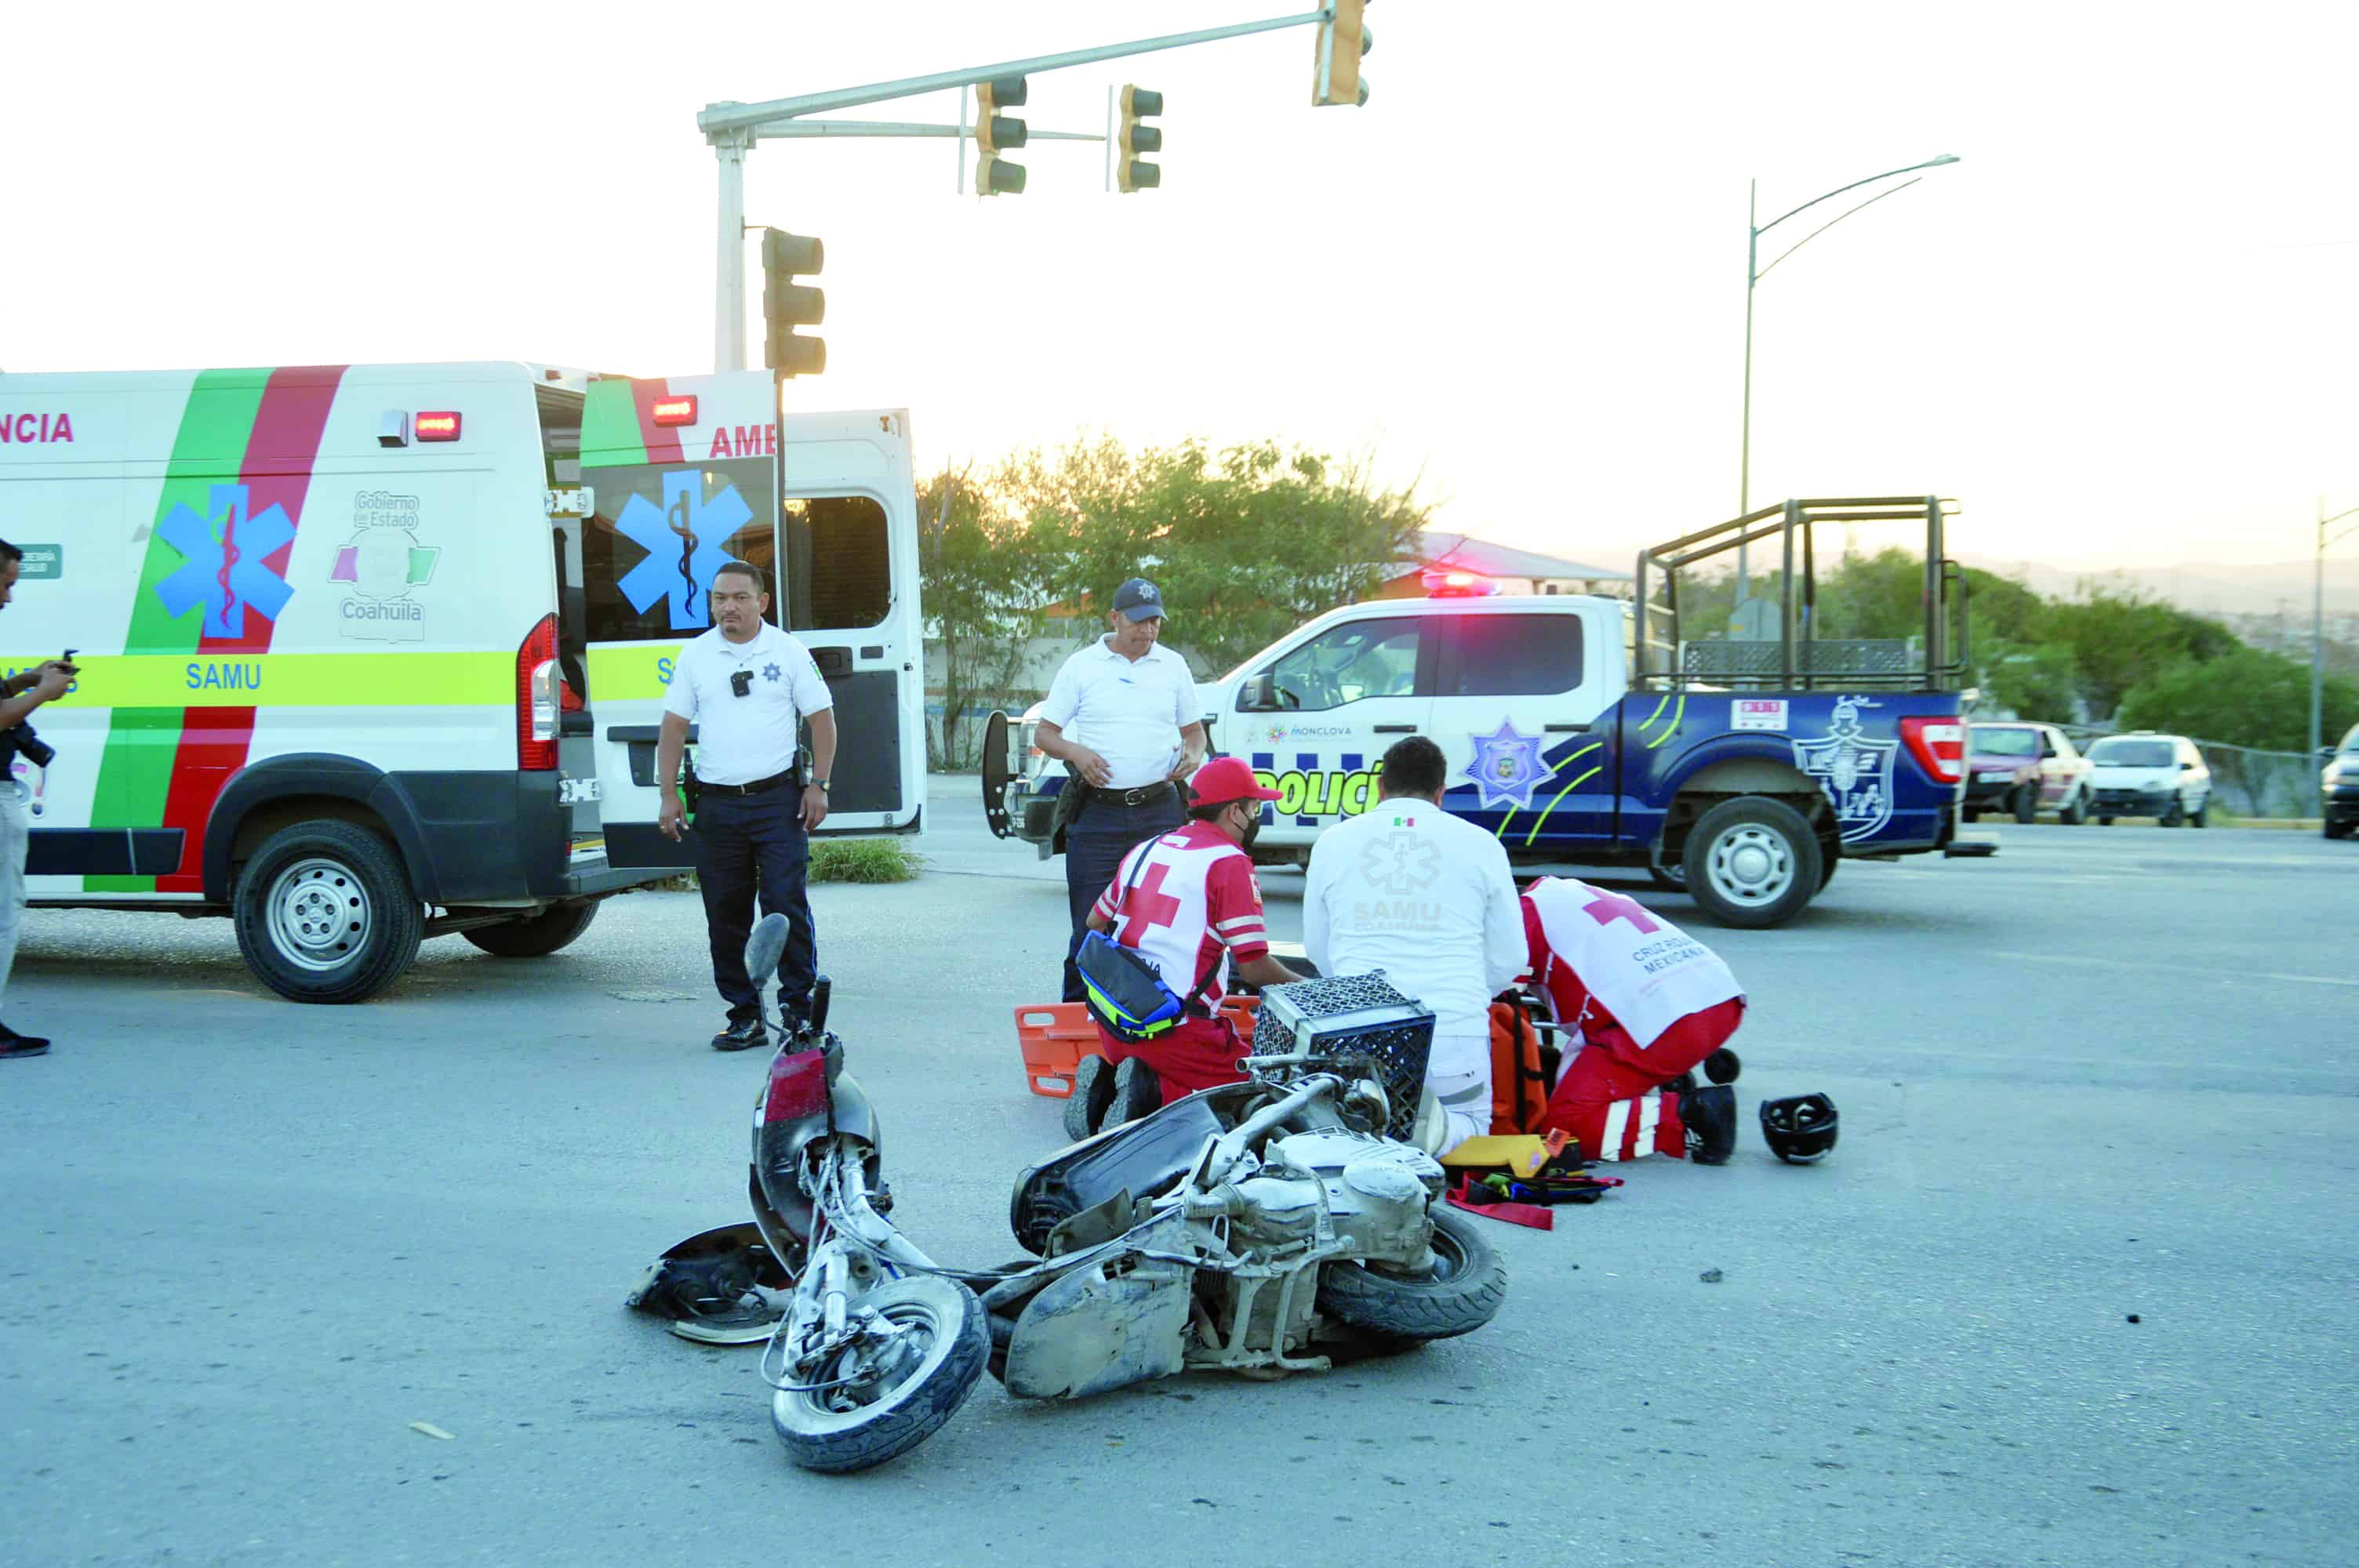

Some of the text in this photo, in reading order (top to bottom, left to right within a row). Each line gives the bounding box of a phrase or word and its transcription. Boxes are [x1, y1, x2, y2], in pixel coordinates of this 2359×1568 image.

[358, 494, 416, 510] Gobierno
[370, 511, 415, 526] Estado
[343, 601, 421, 620] Coahuila
[187, 663, 261, 689] SAMU
[1291, 726, 1351, 735] MONCLOVA
[1354, 901, 1441, 920] SAMU
[1633, 942, 1667, 961] CRUZ
[1644, 947, 1705, 975] MEXICANA
